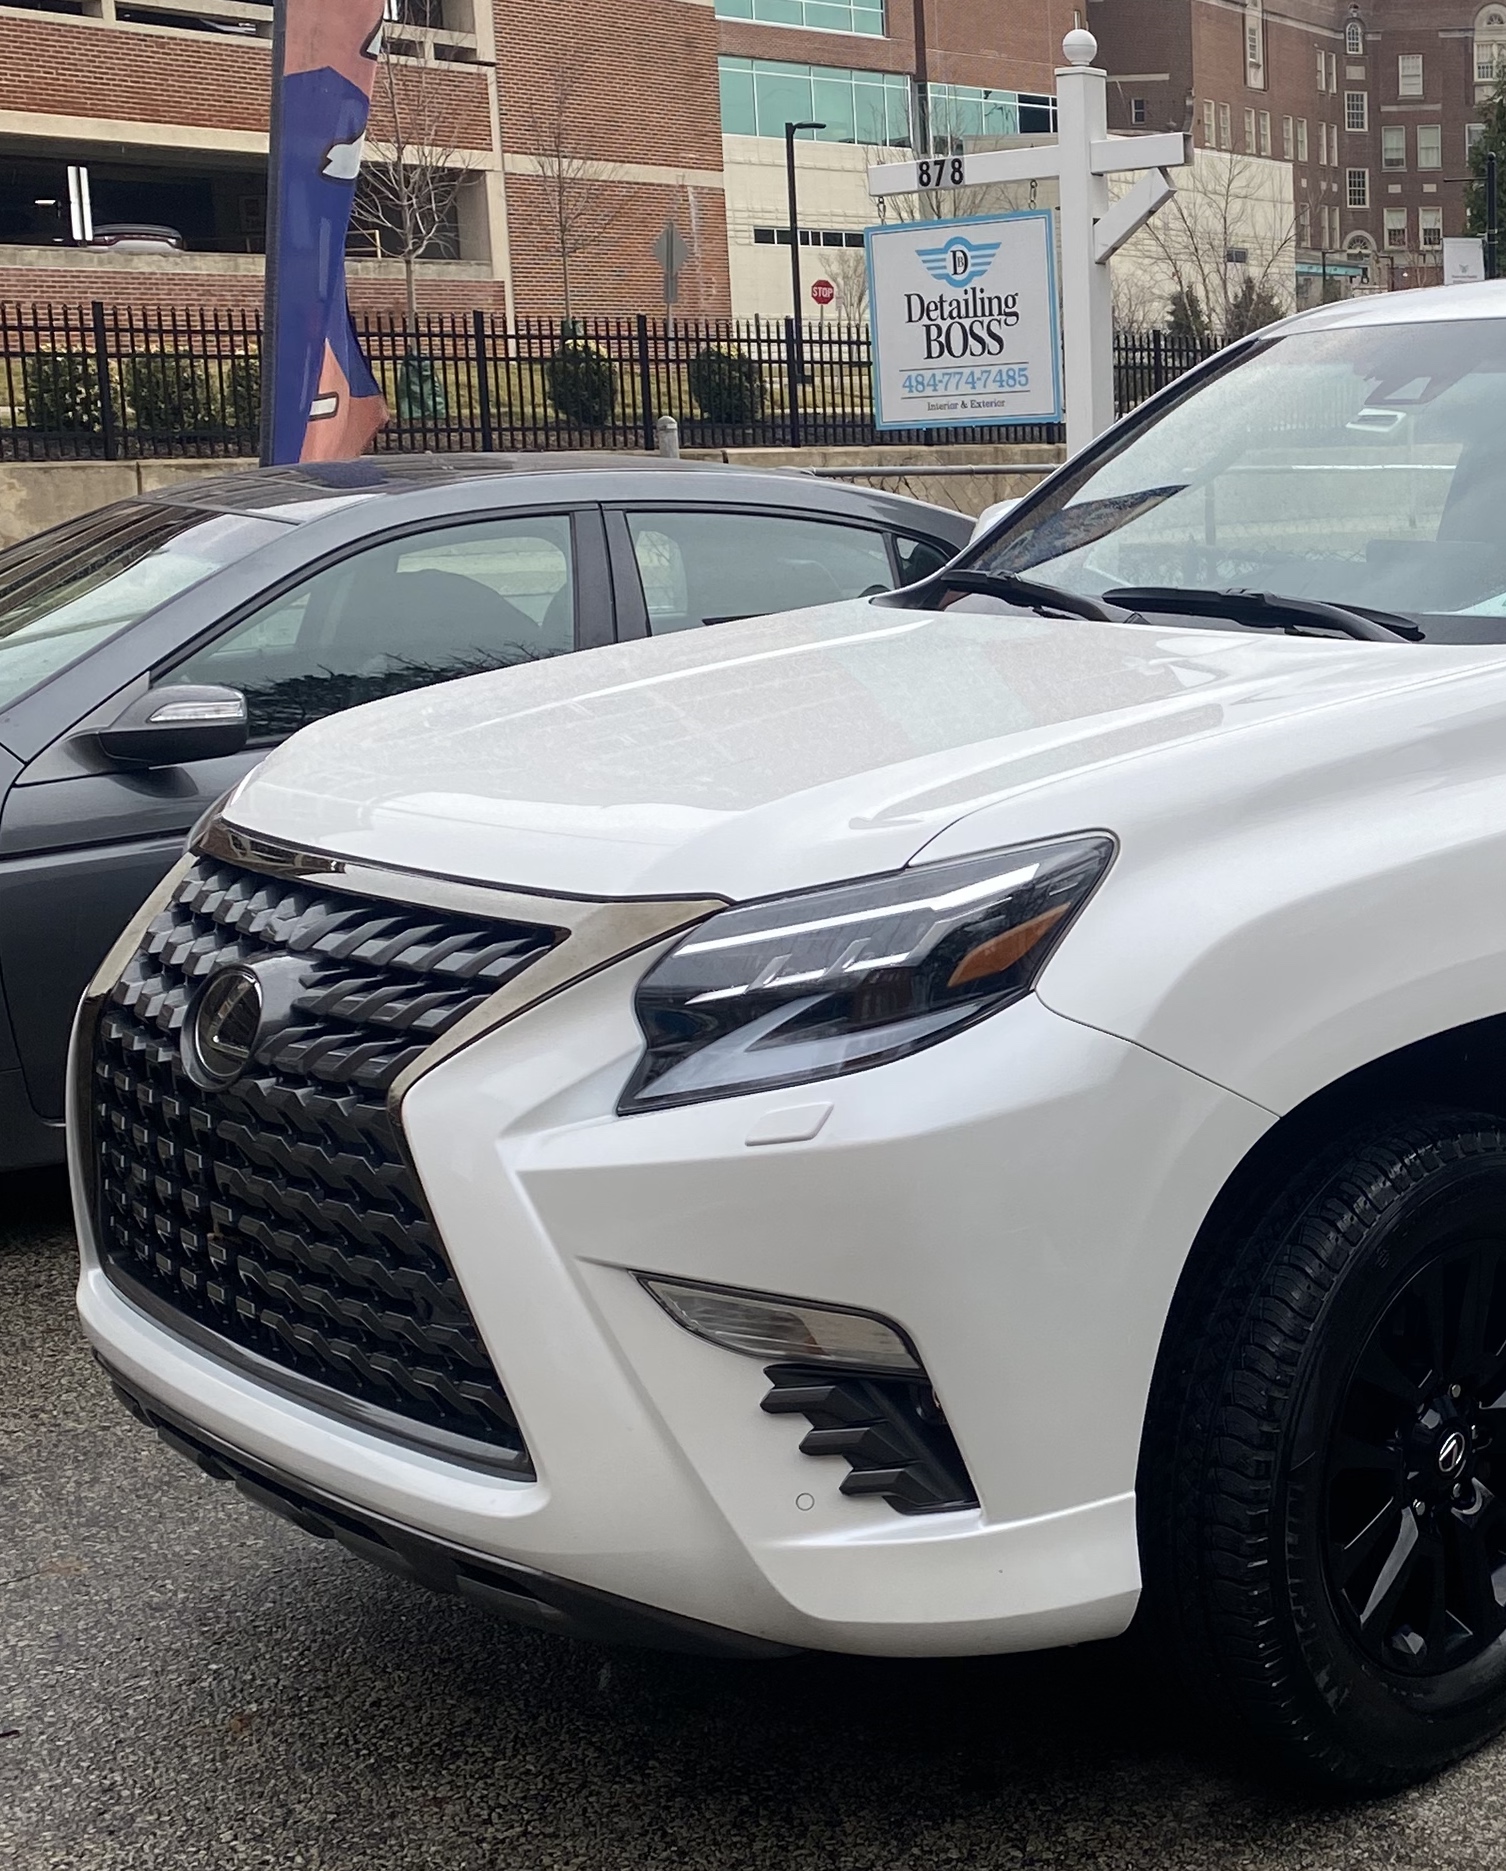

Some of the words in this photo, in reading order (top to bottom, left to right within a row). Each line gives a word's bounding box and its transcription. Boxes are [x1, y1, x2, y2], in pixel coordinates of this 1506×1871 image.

[919, 158, 964, 187] 878
[812, 286, 833, 298] STOP
[904, 286, 1020, 327] Detailing
[922, 317, 1005, 360] BOSS
[902, 367, 1030, 394] 484-774-7485
[927, 401, 959, 411] Interior
[961, 400, 968, 409] &
[970, 398, 1006, 409] Exterior
